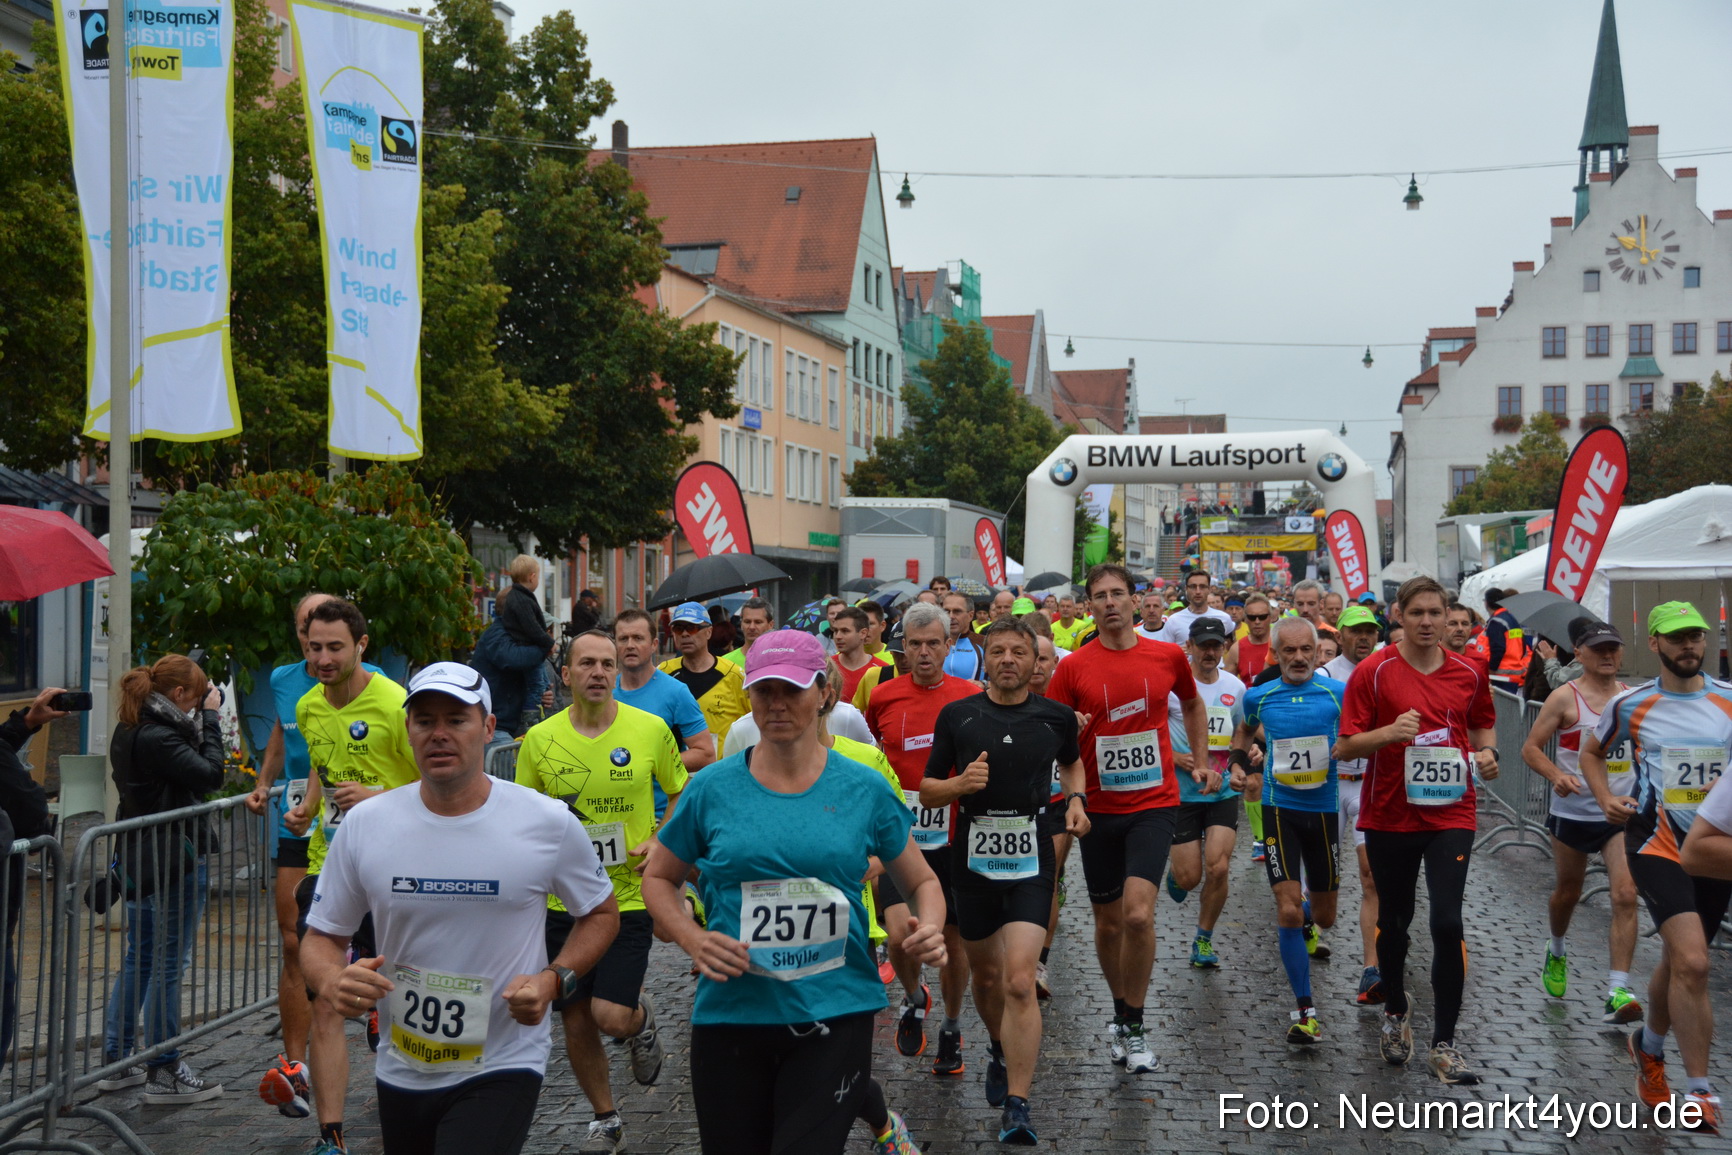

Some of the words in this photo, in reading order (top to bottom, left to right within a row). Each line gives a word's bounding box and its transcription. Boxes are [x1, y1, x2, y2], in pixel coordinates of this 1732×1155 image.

[1087, 445, 1163, 467] BMW
[1171, 443, 1306, 470] Laufsport
[1552, 451, 1618, 600] REWE
[1245, 538, 1272, 548] ZIEL
[1208, 717, 1225, 733] 47
[347, 742, 369, 752] Partl
[914, 738, 931, 746] DEHN
[1104, 745, 1155, 771] 2588
[1290, 750, 1312, 770] 21
[610, 769, 633, 777] Partl
[1412, 761, 1460, 783] 2551
[1607, 763, 1622, 772] fried
[1114, 772, 1149, 784] Berthold
[1293, 774, 1312, 783] Willi
[1678, 762, 1722, 786] 215
[1423, 788, 1451, 797] Markus
[586, 798, 602, 806] THE
[604, 797, 625, 805] NEXT
[595, 806, 608, 814] 100
[610, 804, 634, 813] YEARS
[586, 825, 617, 835] OCK
[912, 834, 927, 842] rnst
[975, 831, 1032, 856] 2388
[592, 838, 617, 863] 91
[987, 861, 1018, 871] Günter
[423, 881, 495, 893] BÜSCHEL
[752, 902, 836, 942] 2571
[772, 949, 819, 968] Sibylle
[404, 990, 466, 1039] 293
[402, 1034, 460, 1062] Wolfgang
